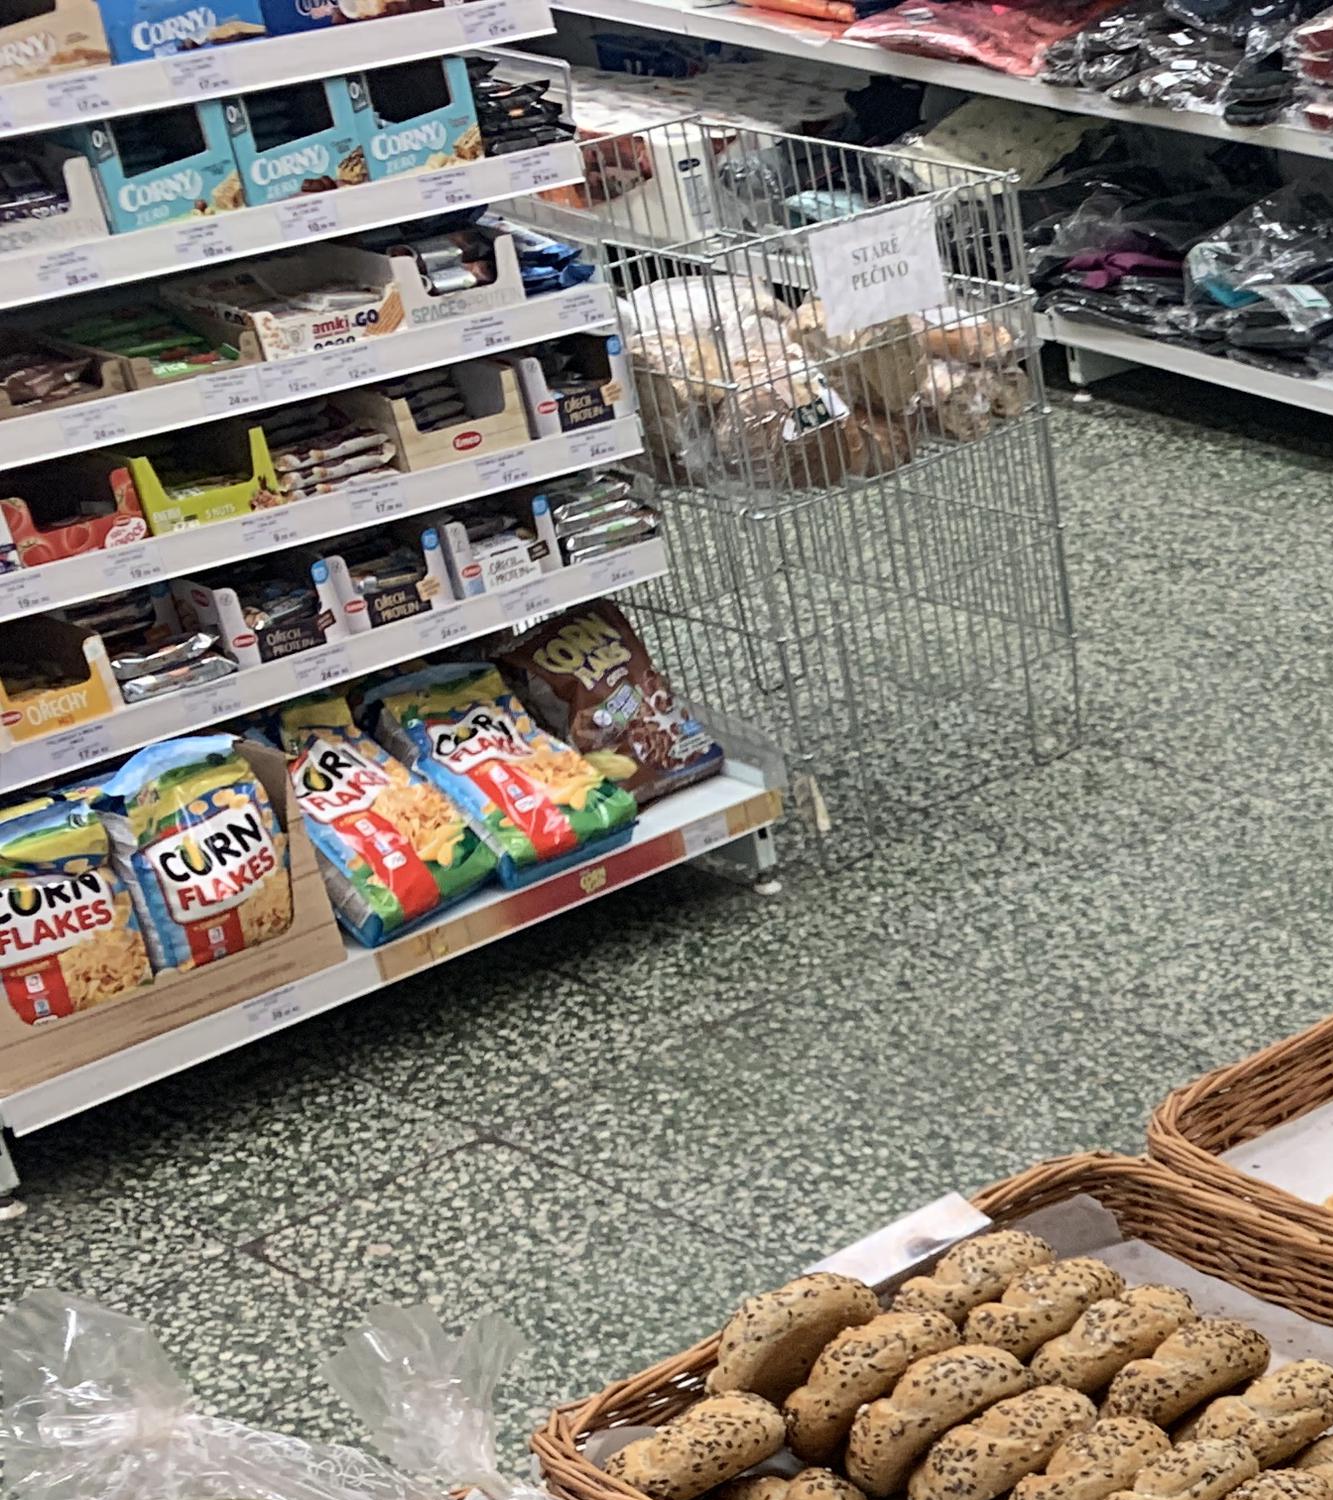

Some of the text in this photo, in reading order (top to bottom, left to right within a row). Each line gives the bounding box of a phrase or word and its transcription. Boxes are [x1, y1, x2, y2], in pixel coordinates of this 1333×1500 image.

[131, 6, 216, 50] CORNY
[370, 120, 447, 160] CORNY
[251, 144, 330, 185] CORNY
[118, 168, 202, 212] CORNY
[851, 232, 899, 265] STARÉ
[851, 260, 908, 291] PEČIVO
[26, 690, 87, 725] OŘECHY
[160, 812, 262, 883] CORN
[179, 846, 275, 911] FLAKES
